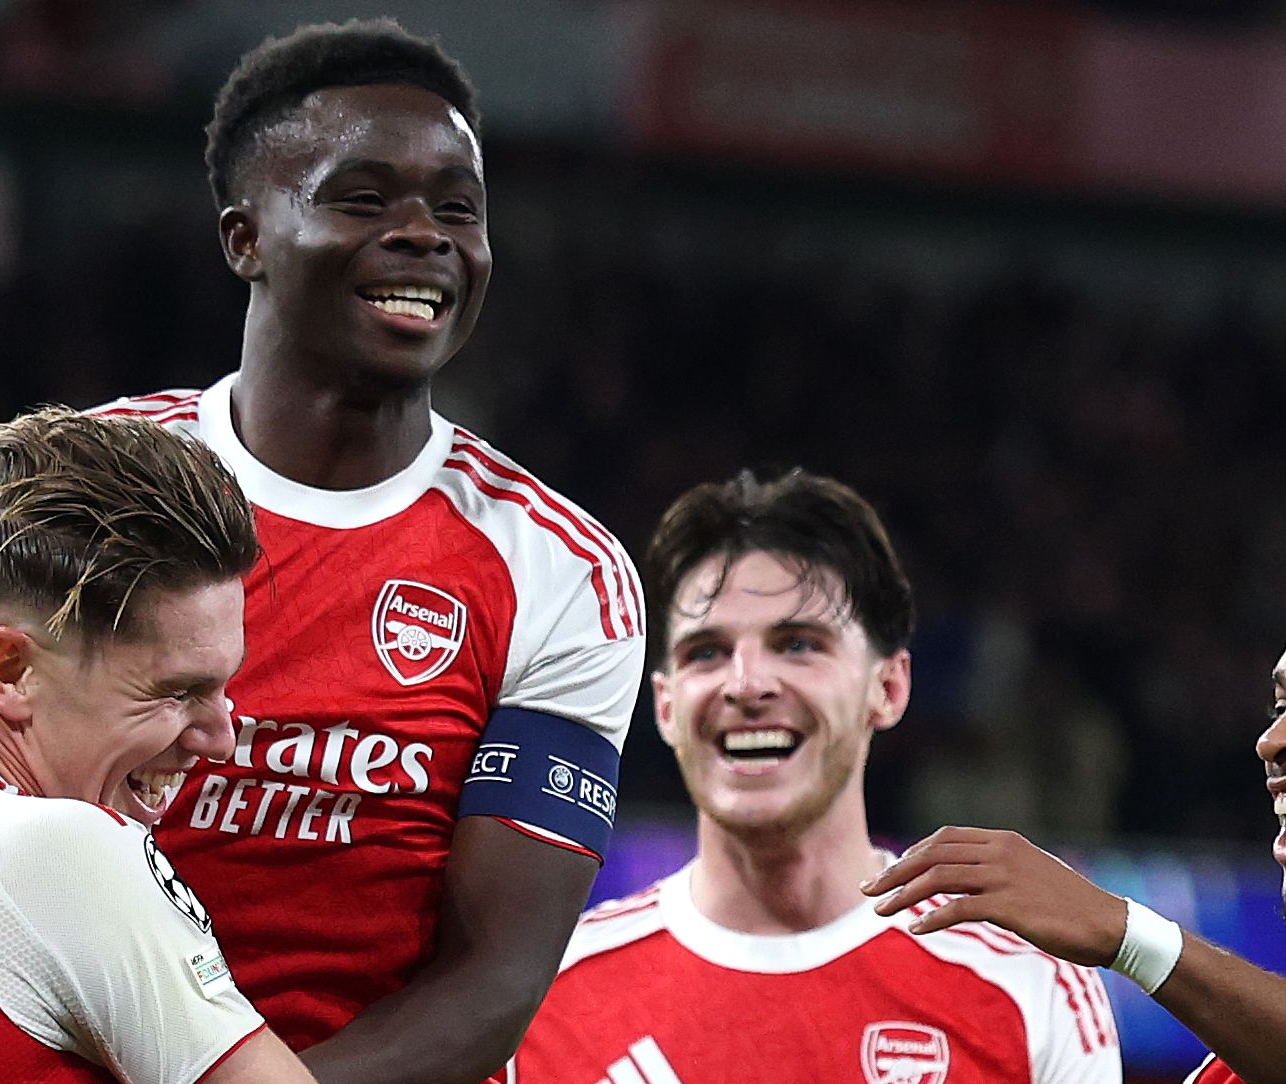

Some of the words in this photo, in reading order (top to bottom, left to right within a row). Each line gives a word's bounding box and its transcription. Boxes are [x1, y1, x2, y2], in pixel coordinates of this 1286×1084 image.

[389, 594, 454, 630] Arsenal
[207, 699, 433, 794] rates
[189, 774, 362, 844] BETTER
